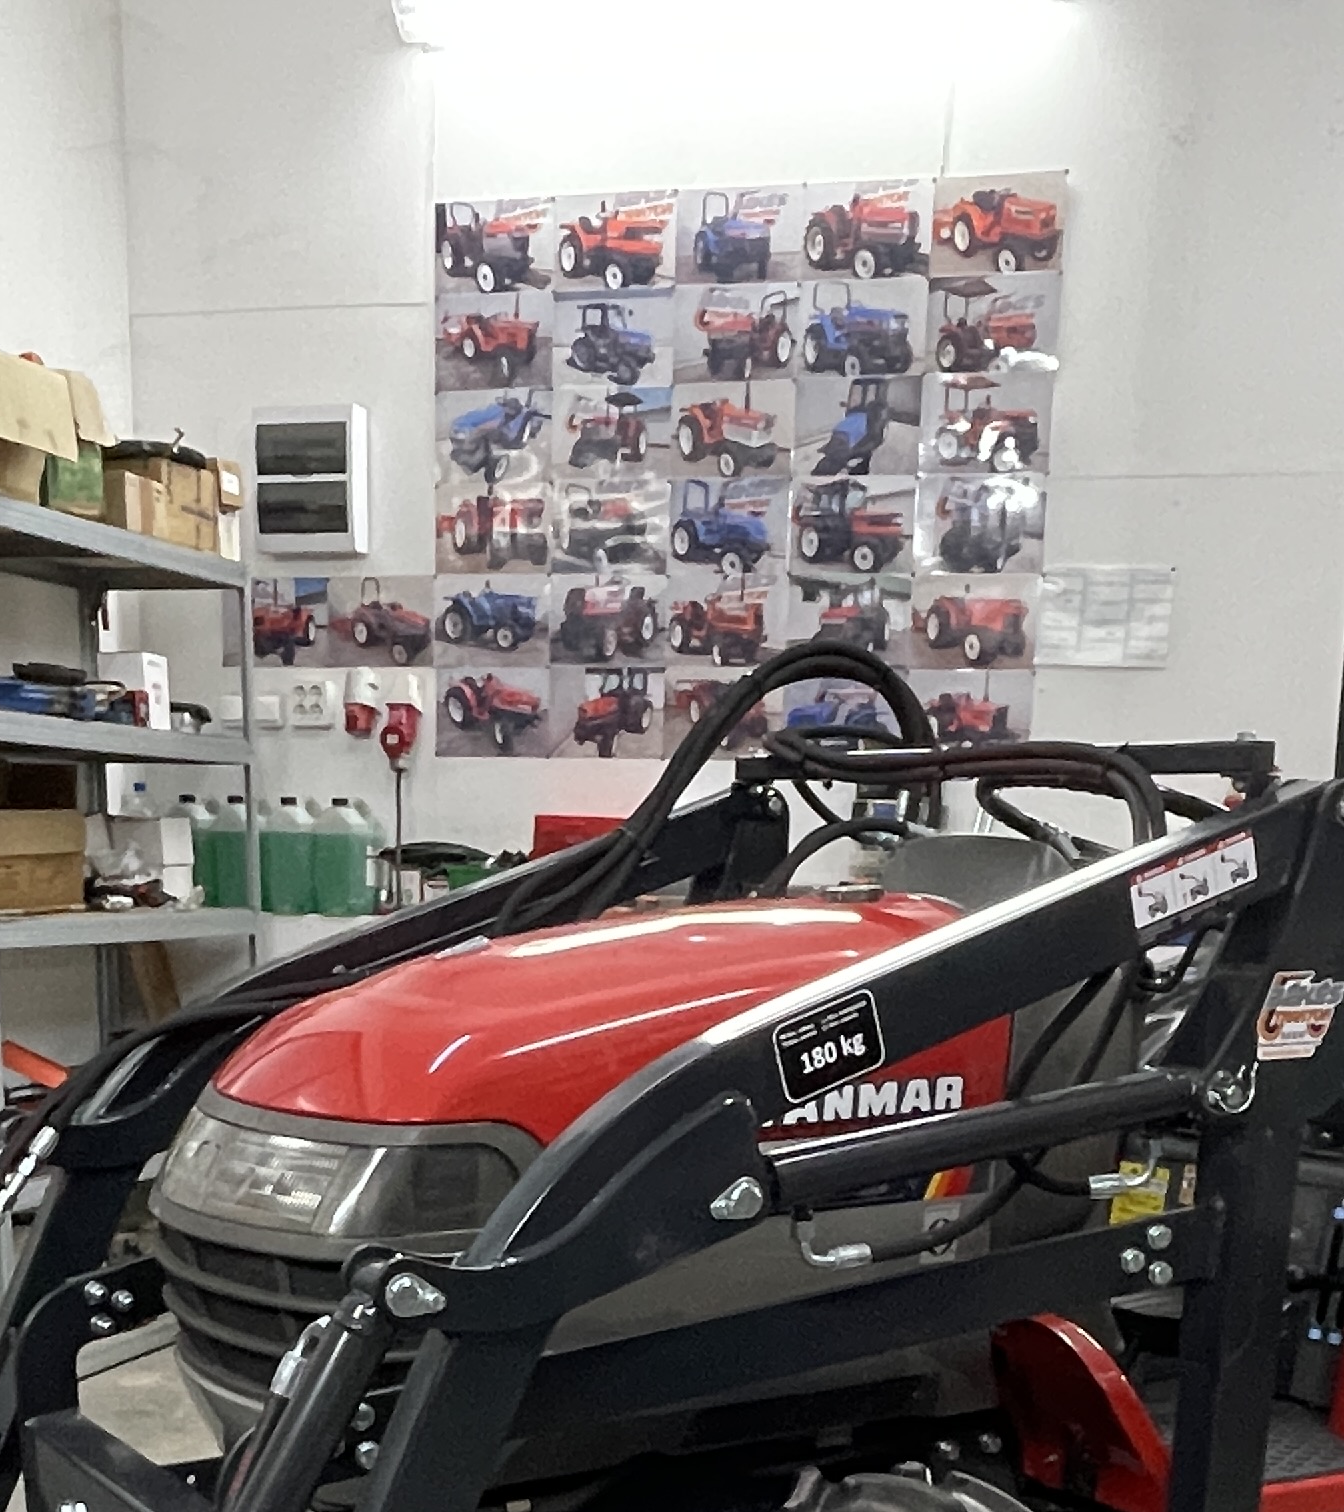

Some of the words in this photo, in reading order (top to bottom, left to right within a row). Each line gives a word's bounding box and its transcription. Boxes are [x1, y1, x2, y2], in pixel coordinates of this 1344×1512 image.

[799, 1041, 838, 1075] 180
[840, 1032, 868, 1057] kg
[761, 1076, 964, 1128] ANMAR
